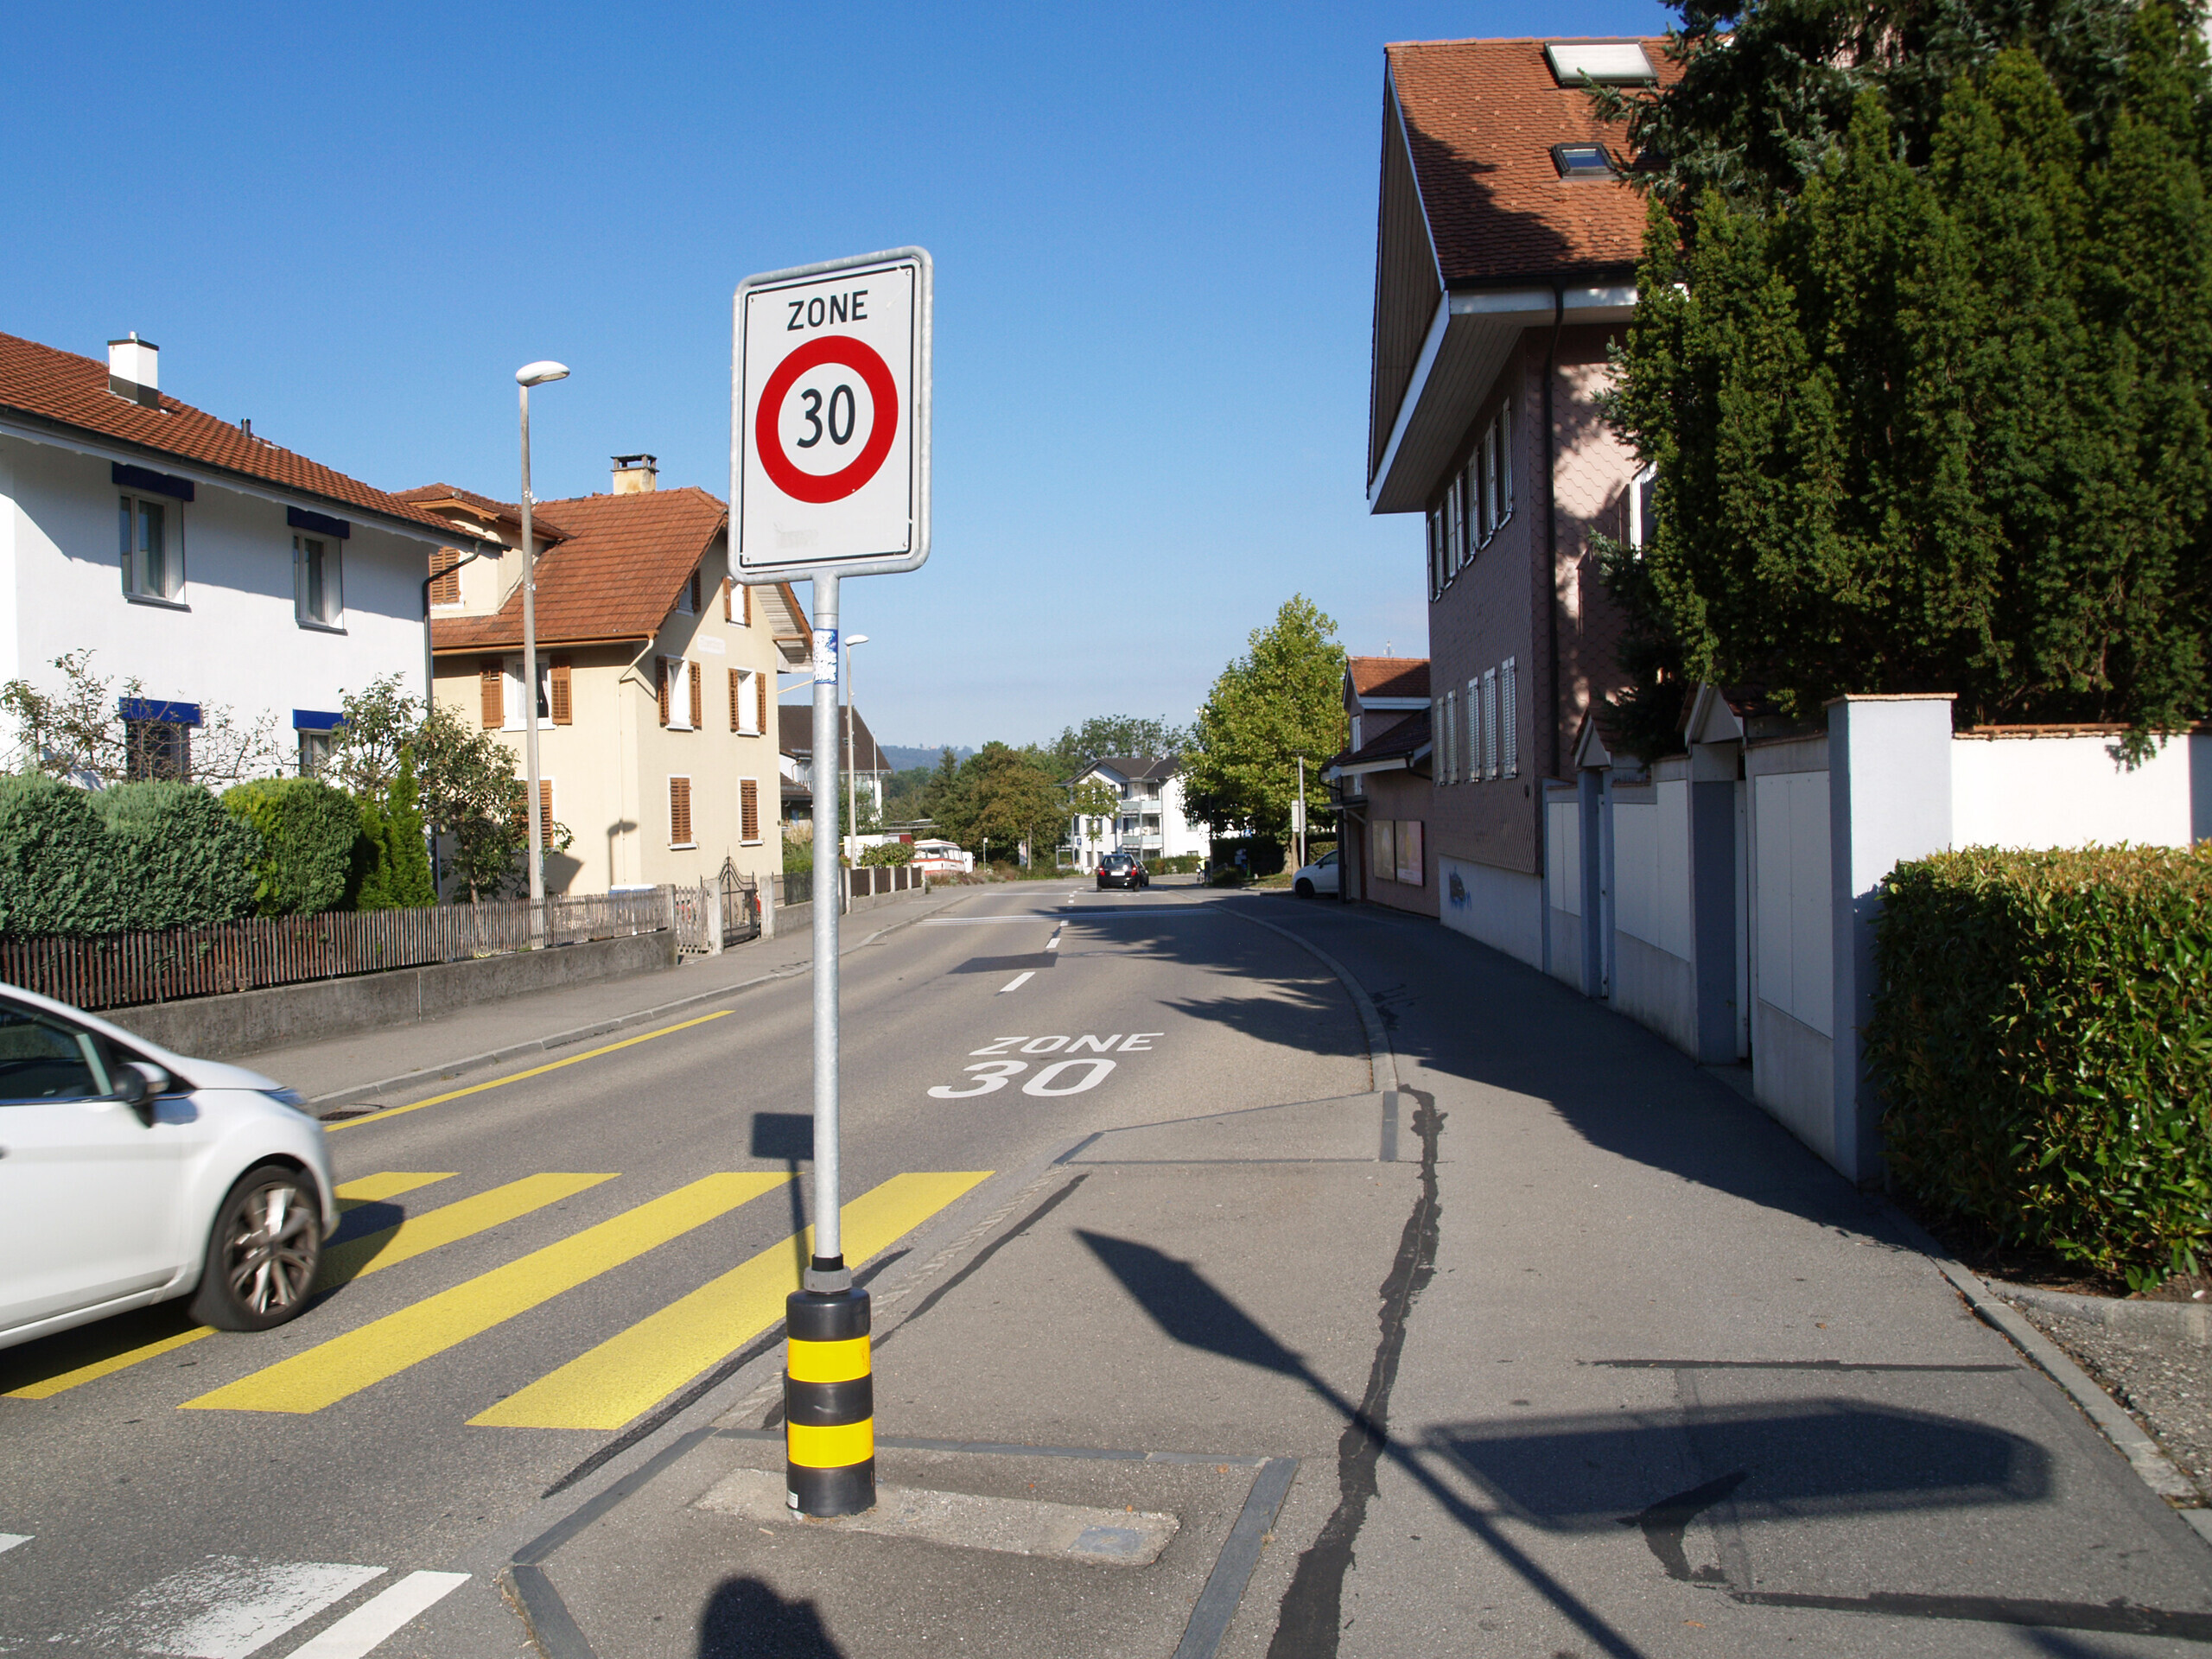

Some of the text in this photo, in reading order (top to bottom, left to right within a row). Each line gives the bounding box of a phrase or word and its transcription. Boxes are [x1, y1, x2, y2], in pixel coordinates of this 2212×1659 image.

[787, 289, 868, 331] ZONE
[796, 384, 855, 448] 30
[969, 1033, 1165, 1056] ZONE
[927, 1058, 1117, 1098] 30
